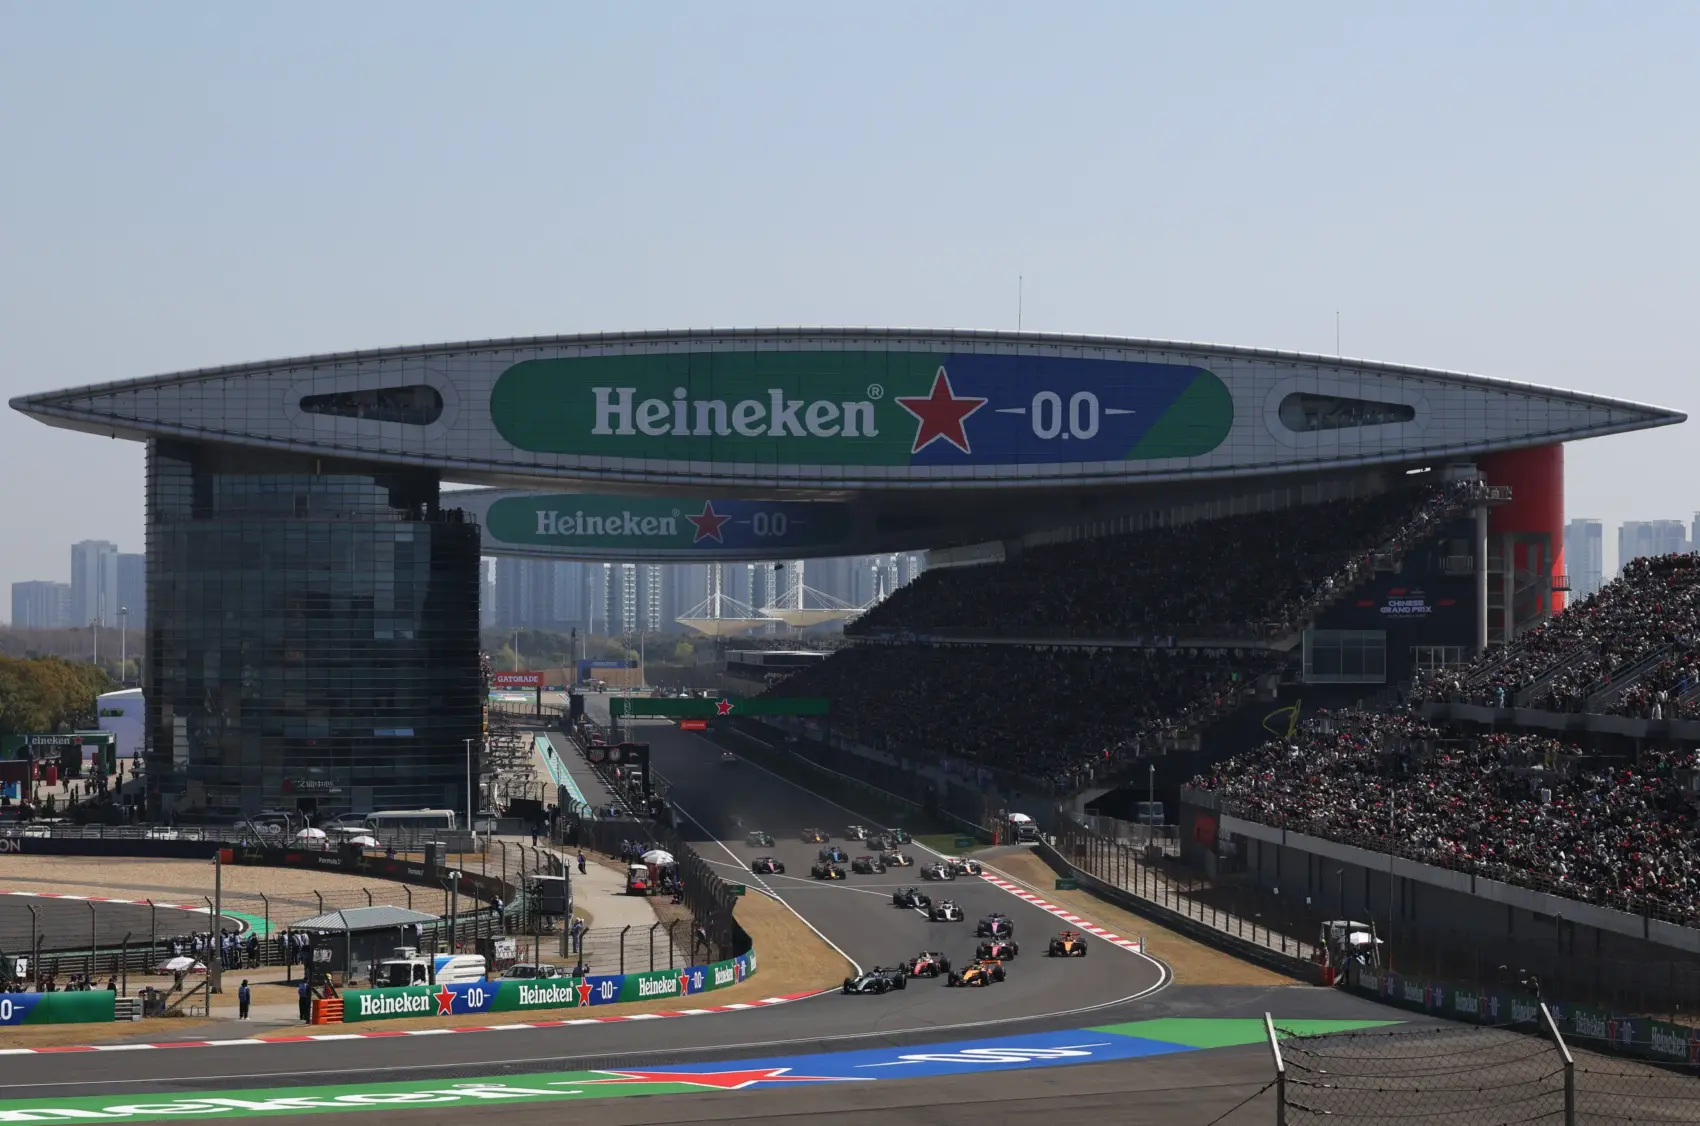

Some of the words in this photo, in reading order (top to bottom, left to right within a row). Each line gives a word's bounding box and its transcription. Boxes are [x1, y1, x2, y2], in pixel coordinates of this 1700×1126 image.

[1032, 391, 1099, 440] 0.0
[753, 512, 787, 536] 0.0
[497, 675, 538, 683] GATORADE
[360, 992, 430, 1015] Heineken
[519, 983, 573, 1005] Heineken
[639, 974, 677, 996] Heineken
